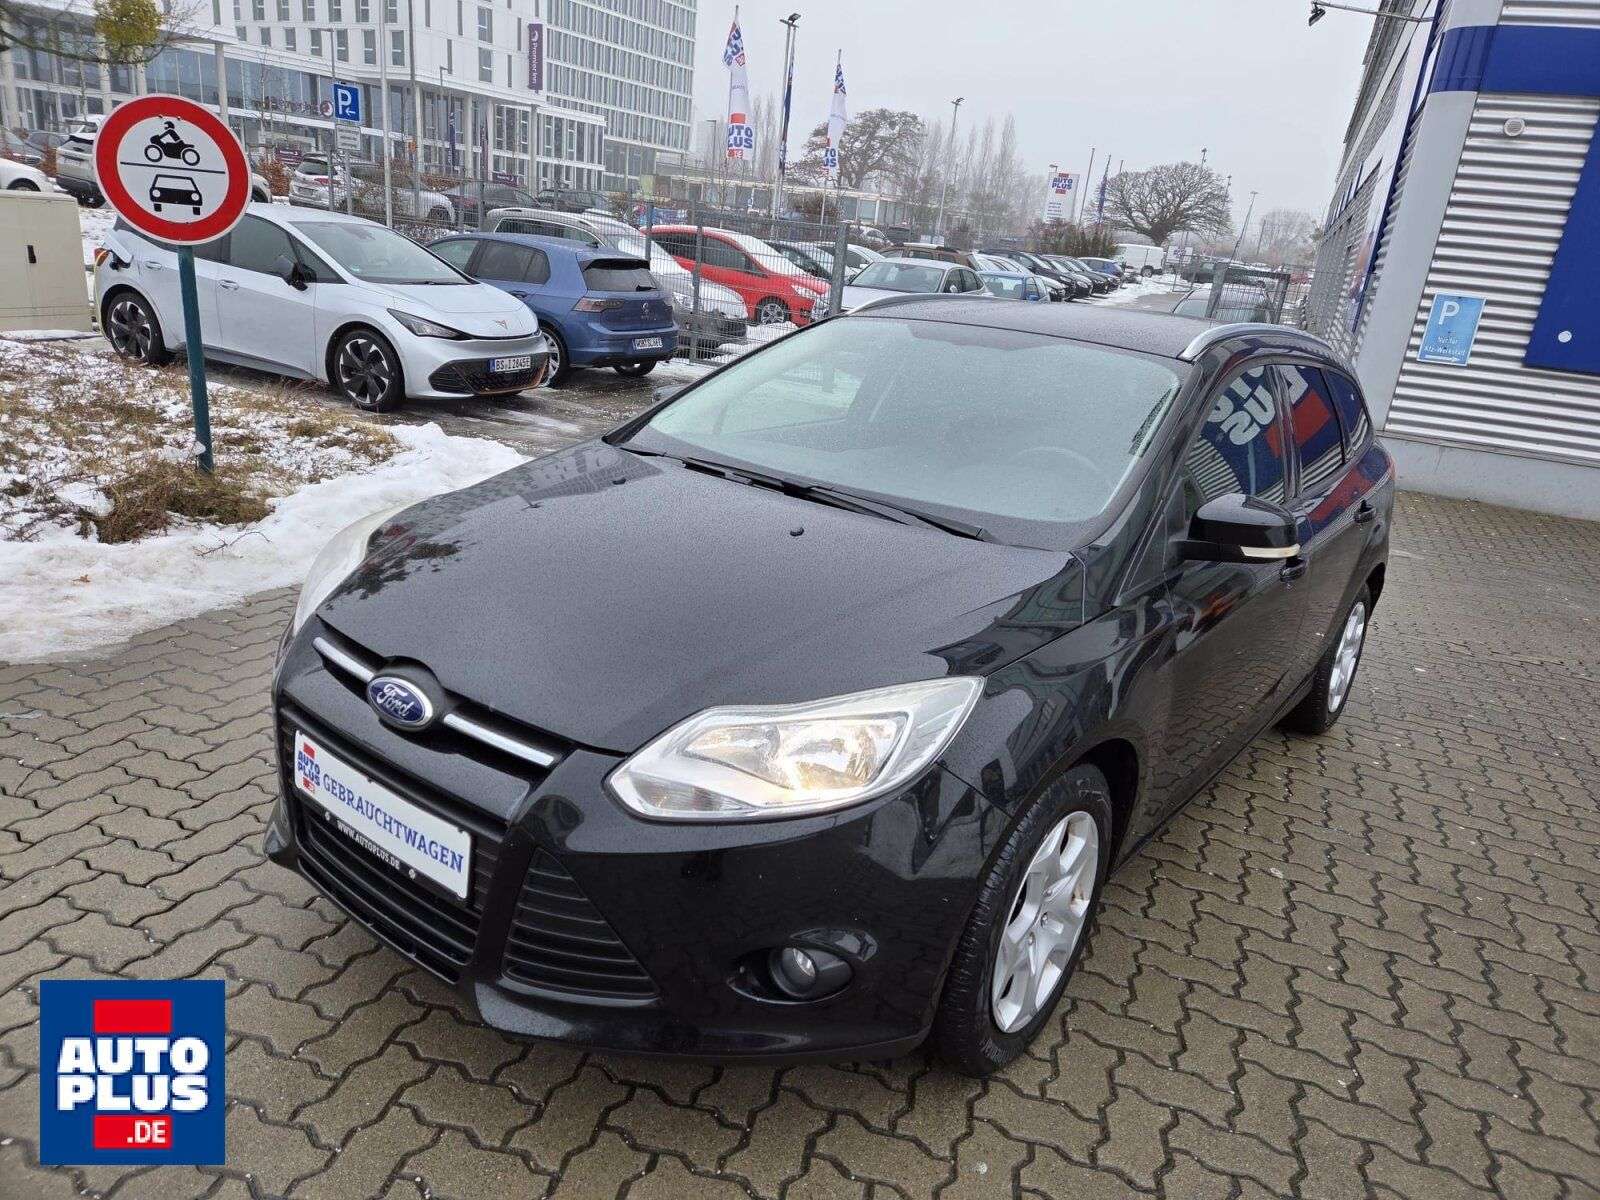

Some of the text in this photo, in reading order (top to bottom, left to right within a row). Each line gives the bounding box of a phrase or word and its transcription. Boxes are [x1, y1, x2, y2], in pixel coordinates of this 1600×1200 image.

[337, 88, 352, 115] P
[727, 124, 753, 138] UTO
[727, 137, 753, 149] LUS
[1438, 300, 1460, 325] P
[377, 683, 415, 717] Ford
[298, 751, 320, 775] AUTO
[298, 761, 320, 786] PLUS
[323, 773, 464, 873] GEBRAUCHTWAGEN
[336, 819, 401, 871] WWW.AUTOPLUS.DE
